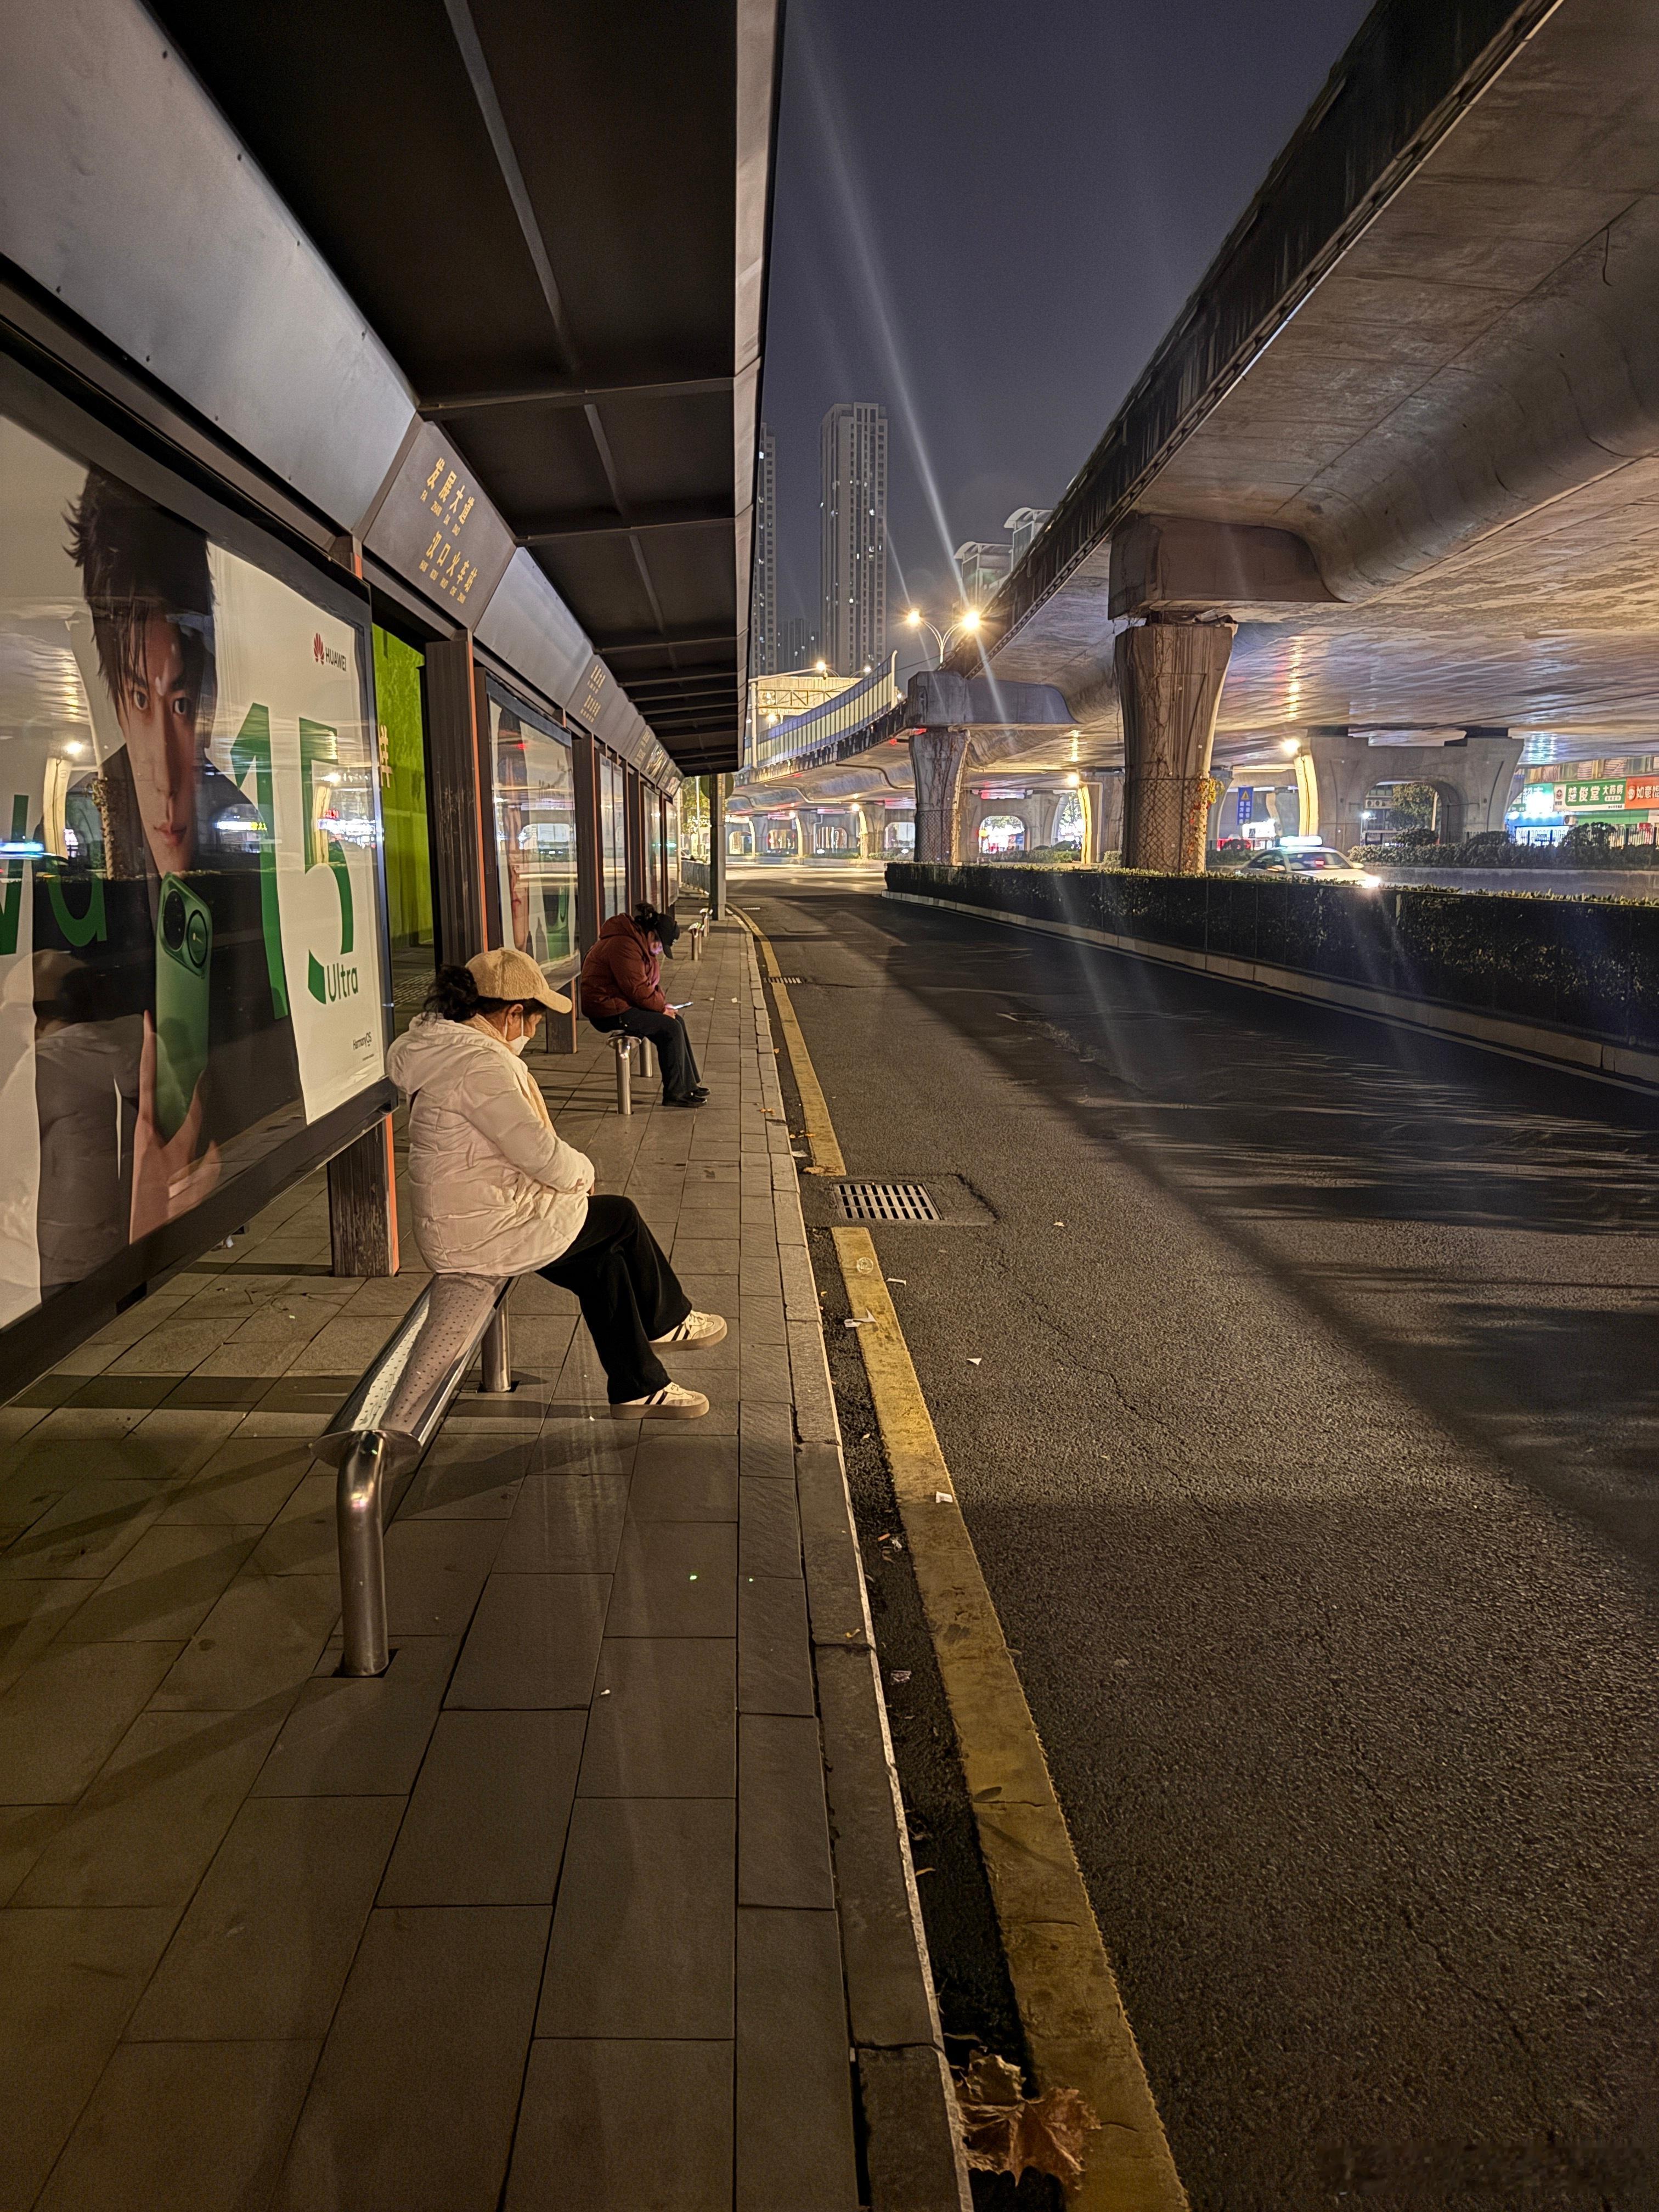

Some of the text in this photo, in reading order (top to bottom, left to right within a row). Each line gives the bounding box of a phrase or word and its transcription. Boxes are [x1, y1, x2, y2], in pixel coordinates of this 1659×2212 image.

[427, 457, 475, 524] 发展大道
[426, 531, 478, 592] 汉口火车站
[325, 646, 347, 672] HUAWEI
[1567, 786, 1601, 803] 楚俊堂
[1602, 784, 1624, 795] 大药房
[327, 963, 359, 1002] Ultra
[353, 1031, 371, 1050] HarmonyOS
